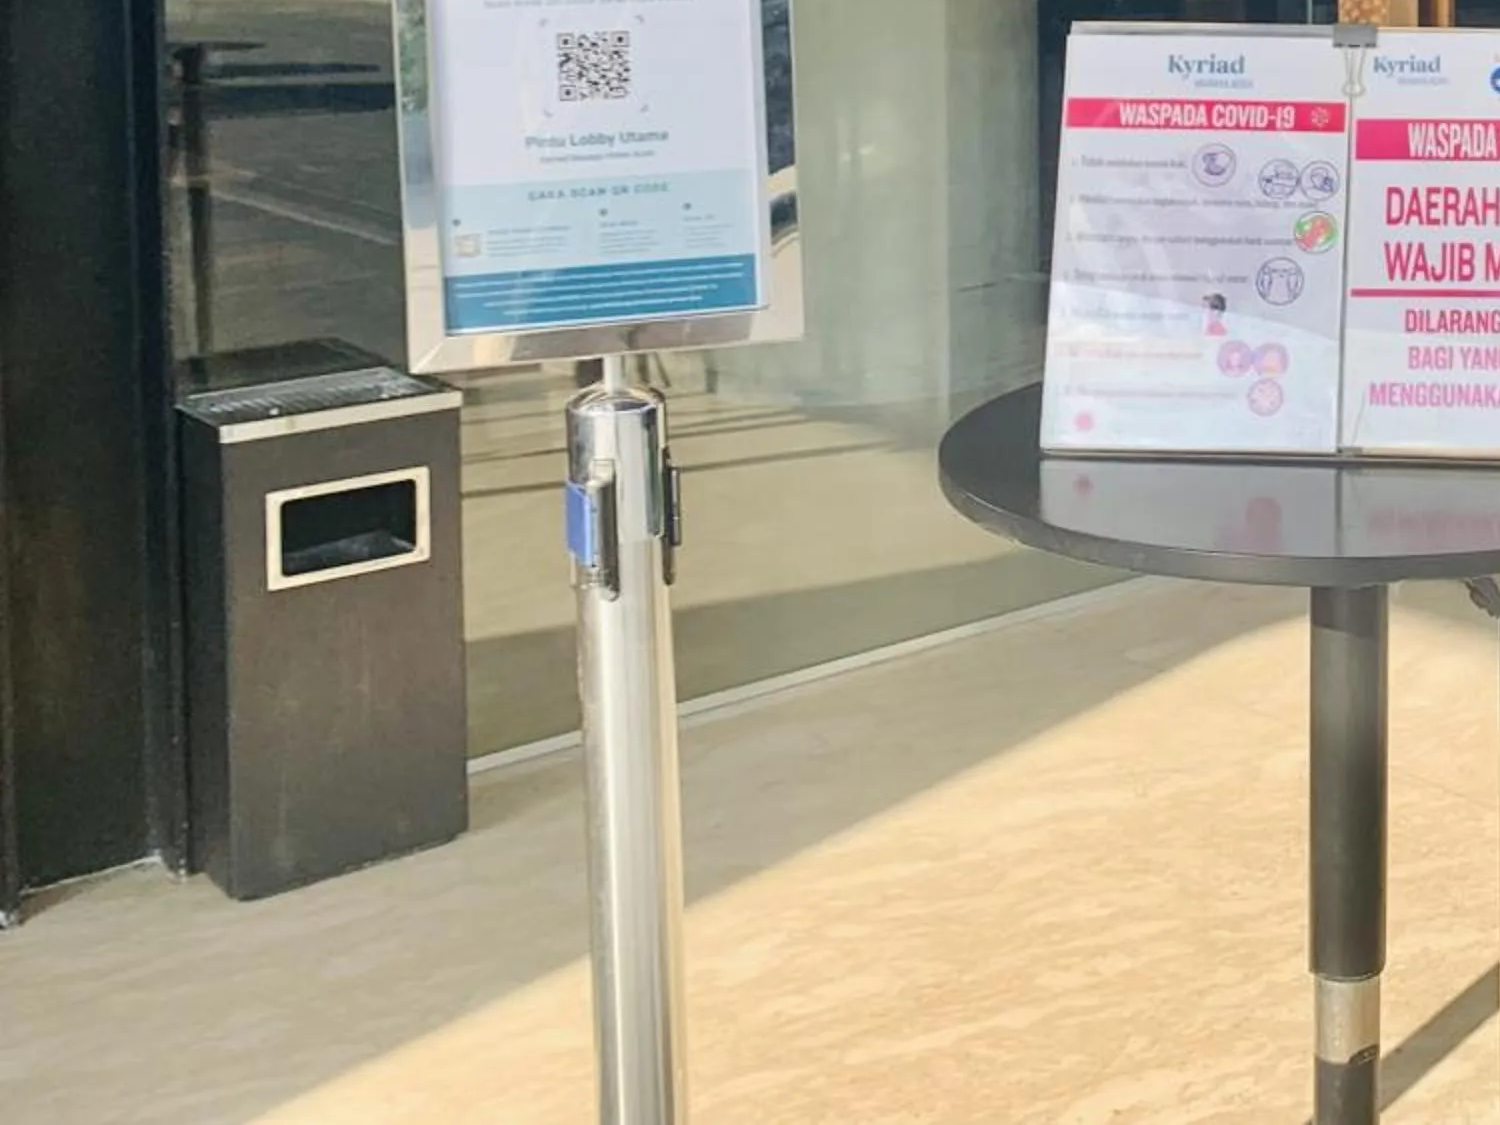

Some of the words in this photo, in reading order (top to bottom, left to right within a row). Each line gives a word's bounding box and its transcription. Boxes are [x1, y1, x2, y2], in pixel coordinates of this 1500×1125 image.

[1167, 52, 1246, 80] Kyriad
[1373, 55, 1441, 77] Kyriad
[1119, 101, 1208, 129] WASPADA
[1211, 104, 1296, 130] COVID-19
[569, 132, 615, 148] Lobby
[1407, 122, 1498, 159] WASPADA
[1385, 186, 1500, 227] DAERAH
[1383, 241, 1476, 283] WAJIB
[1408, 346, 1454, 371] BAGI
